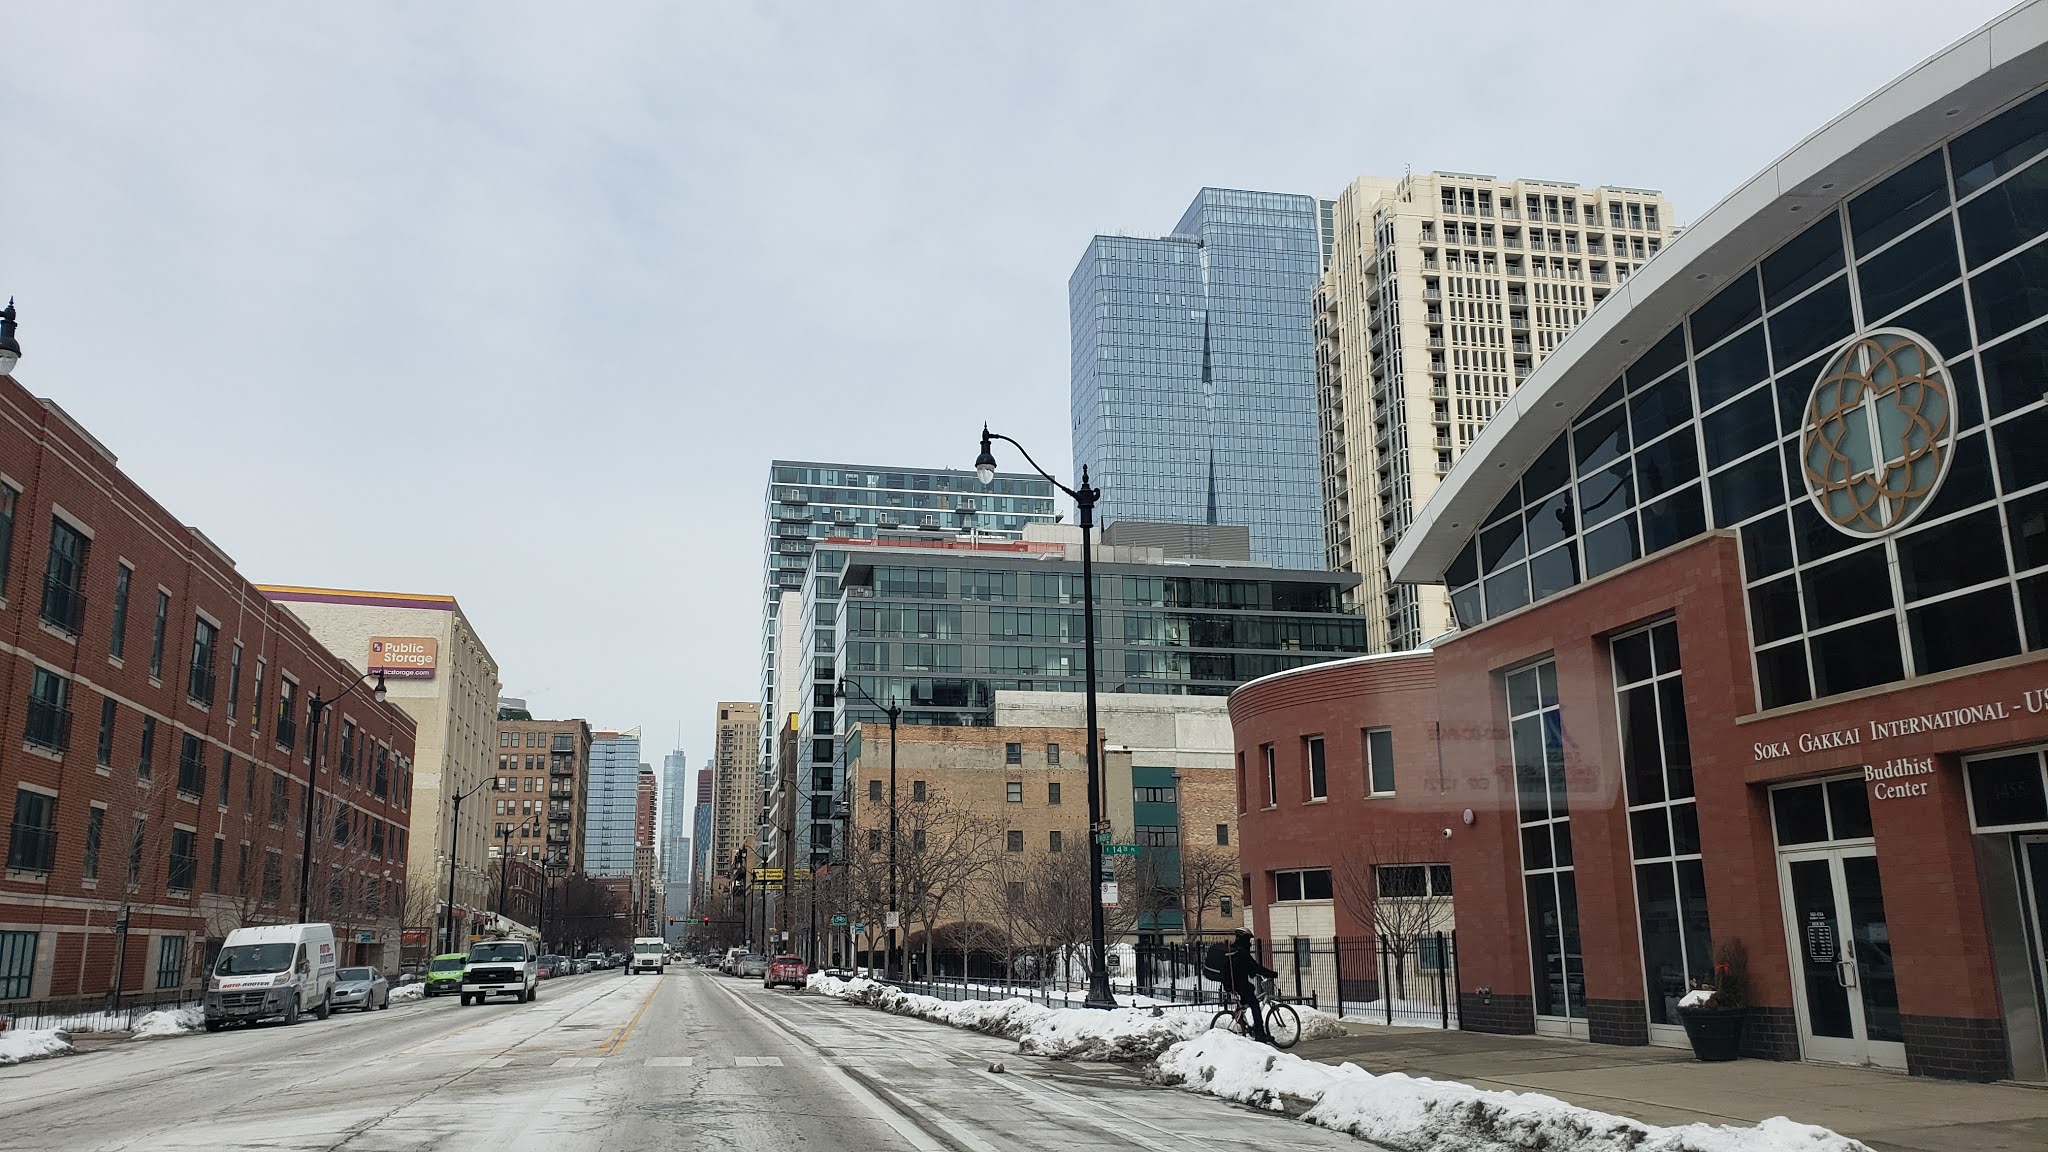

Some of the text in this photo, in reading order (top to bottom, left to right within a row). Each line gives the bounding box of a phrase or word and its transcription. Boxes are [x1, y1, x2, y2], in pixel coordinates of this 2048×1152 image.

[385, 643, 424, 653] Public
[384, 652, 433, 666] Storage
[1754, 742, 1791, 761] SOKA
[1798, 727, 1861, 753] GAKKAI
[1869, 701, 2009, 741] INTERNATIONAL
[1862, 757, 1936, 782] Buddhist
[1874, 782, 1928, 800] Center
